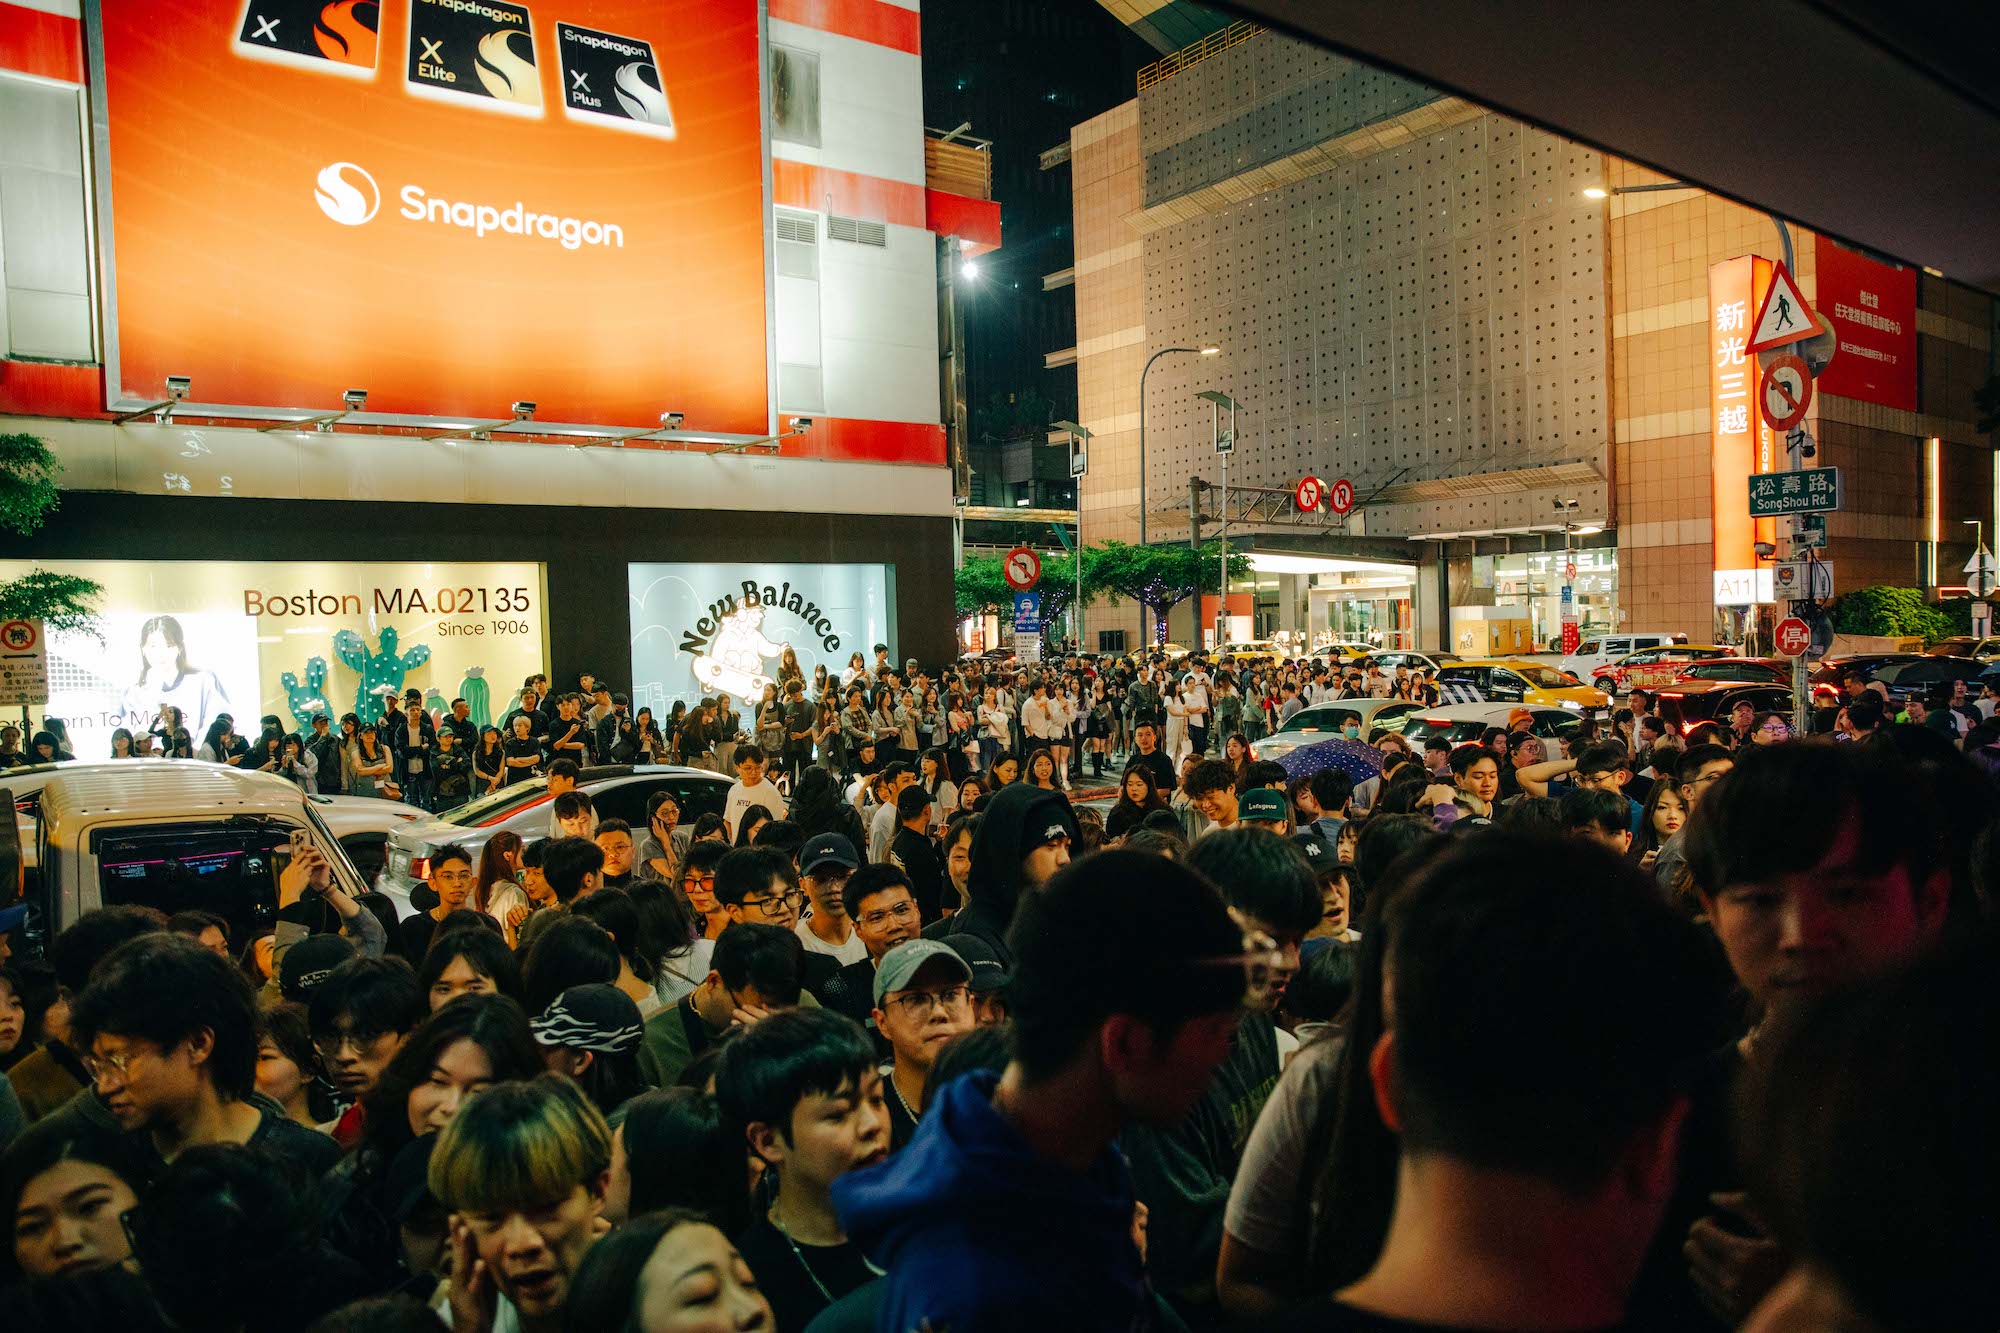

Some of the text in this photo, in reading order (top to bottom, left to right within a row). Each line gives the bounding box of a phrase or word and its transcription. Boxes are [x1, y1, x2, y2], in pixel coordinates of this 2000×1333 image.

[421, 0, 523, 24] napdragon
[251, 14, 280, 42] X
[418, 36, 444, 65] X
[564, 29, 648, 58] Snapdragon
[418, 61, 456, 83] Elite
[570, 69, 592, 93] X
[572, 91, 602, 107] Plus
[400, 185, 624, 250] Snapdragon
[1716, 300, 1748, 436] 新光三越
[1757, 473, 1828, 497] 松壽路
[1757, 494, 1829, 512] SongShou Rd.
[1718, 578, 1750, 597] A11
[244, 587, 530, 617] Boston MA.02135
[438, 620, 529, 636] Since 1906
[679, 580, 841, 657] New Balance
[1781, 626, 1803, 649] 停
[100, 712, 121, 727] To
[130, 710, 188, 726] Moe
[737, 799, 751, 807] NYU
